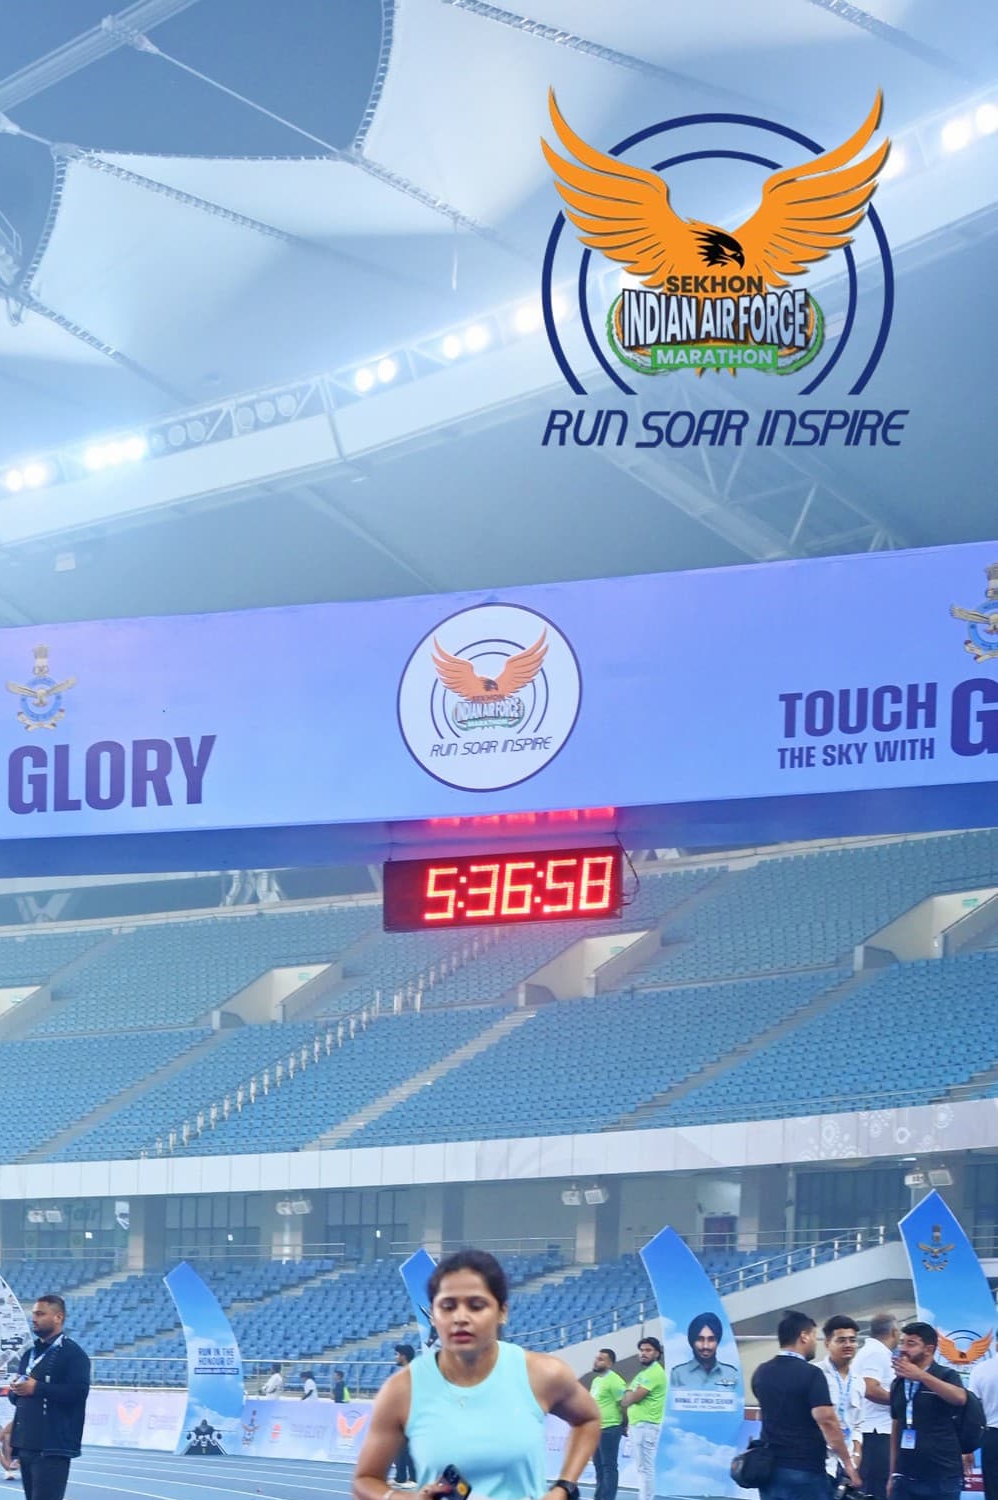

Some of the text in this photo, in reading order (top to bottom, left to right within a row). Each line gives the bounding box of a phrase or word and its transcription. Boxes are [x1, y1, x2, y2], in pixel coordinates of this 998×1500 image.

[779, 682, 938, 738] TOUCH
[8, 734, 217, 815] GLORY
[430, 736, 552, 757] RUN SOAR INSPIRE
[778, 738, 935, 770] THE SKY WITH
[424, 856, 613, 920] 5:36:58
